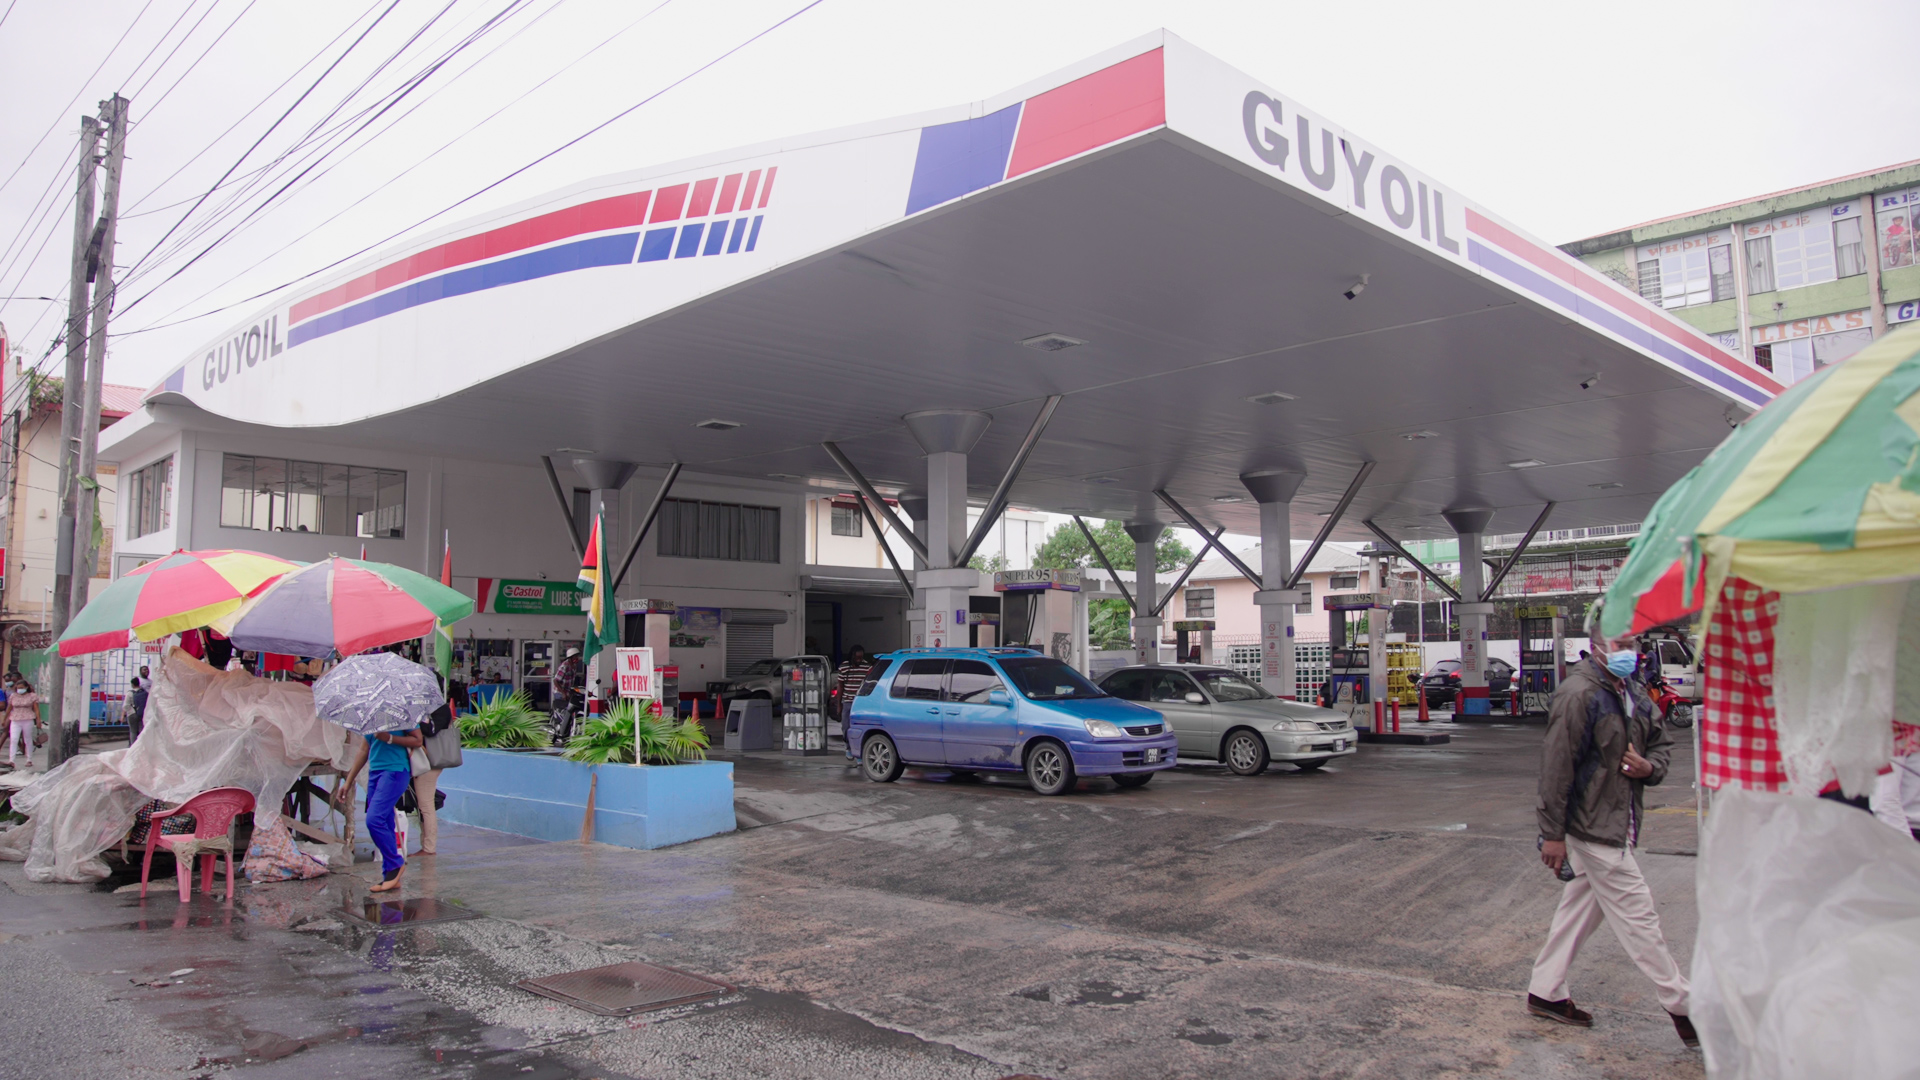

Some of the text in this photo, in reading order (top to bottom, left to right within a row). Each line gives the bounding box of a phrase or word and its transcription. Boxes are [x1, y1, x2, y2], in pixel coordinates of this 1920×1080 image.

[1242, 90, 1460, 256] GUYOIL
[1647, 234, 1720, 257] WHOLE
[1747, 214, 1811, 236] SALE
[1831, 204, 1850, 217] &
[1757, 310, 1864, 344] LISA'S
[202, 313, 283, 392] GUYOIL
[513, 586, 543, 598] Castrol
[551, 590, 573, 607] LUBE
[627, 654, 641, 671] NO
[621, 675, 648, 692] ENTRY
